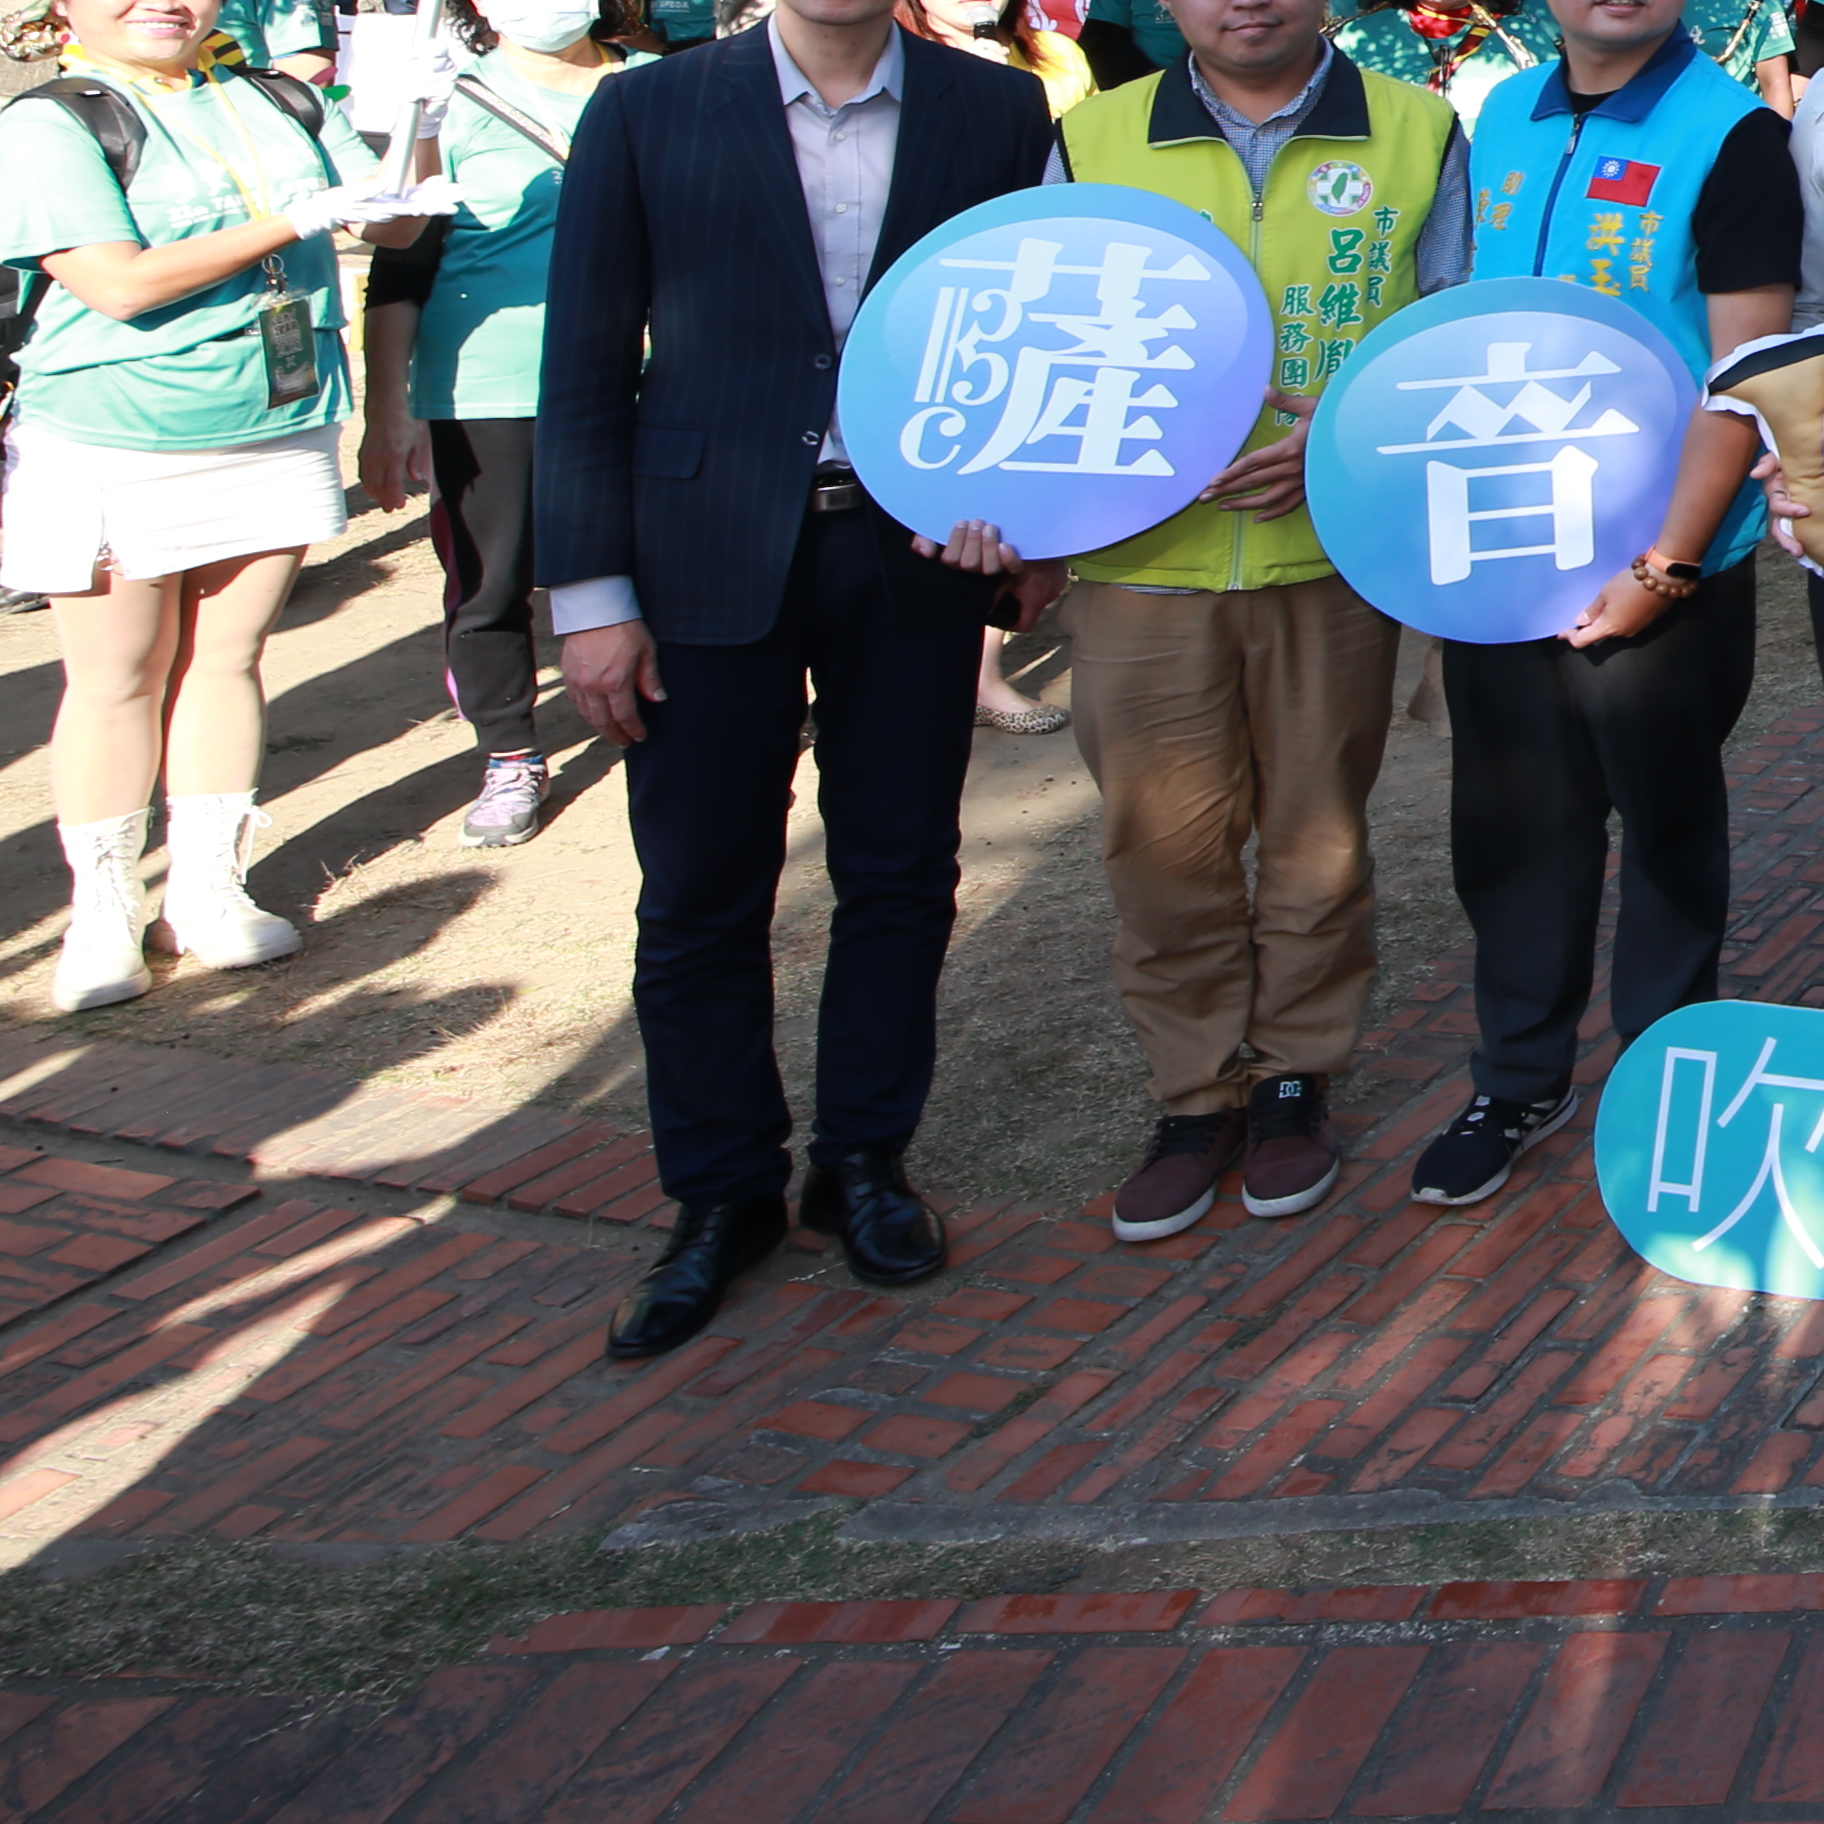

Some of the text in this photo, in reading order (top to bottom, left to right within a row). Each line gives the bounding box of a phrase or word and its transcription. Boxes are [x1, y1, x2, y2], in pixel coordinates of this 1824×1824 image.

[1366, 205, 1401, 308] 市議員
[1630, 211, 1665, 293] 市議員
[1376, 342, 1641, 586] 音
